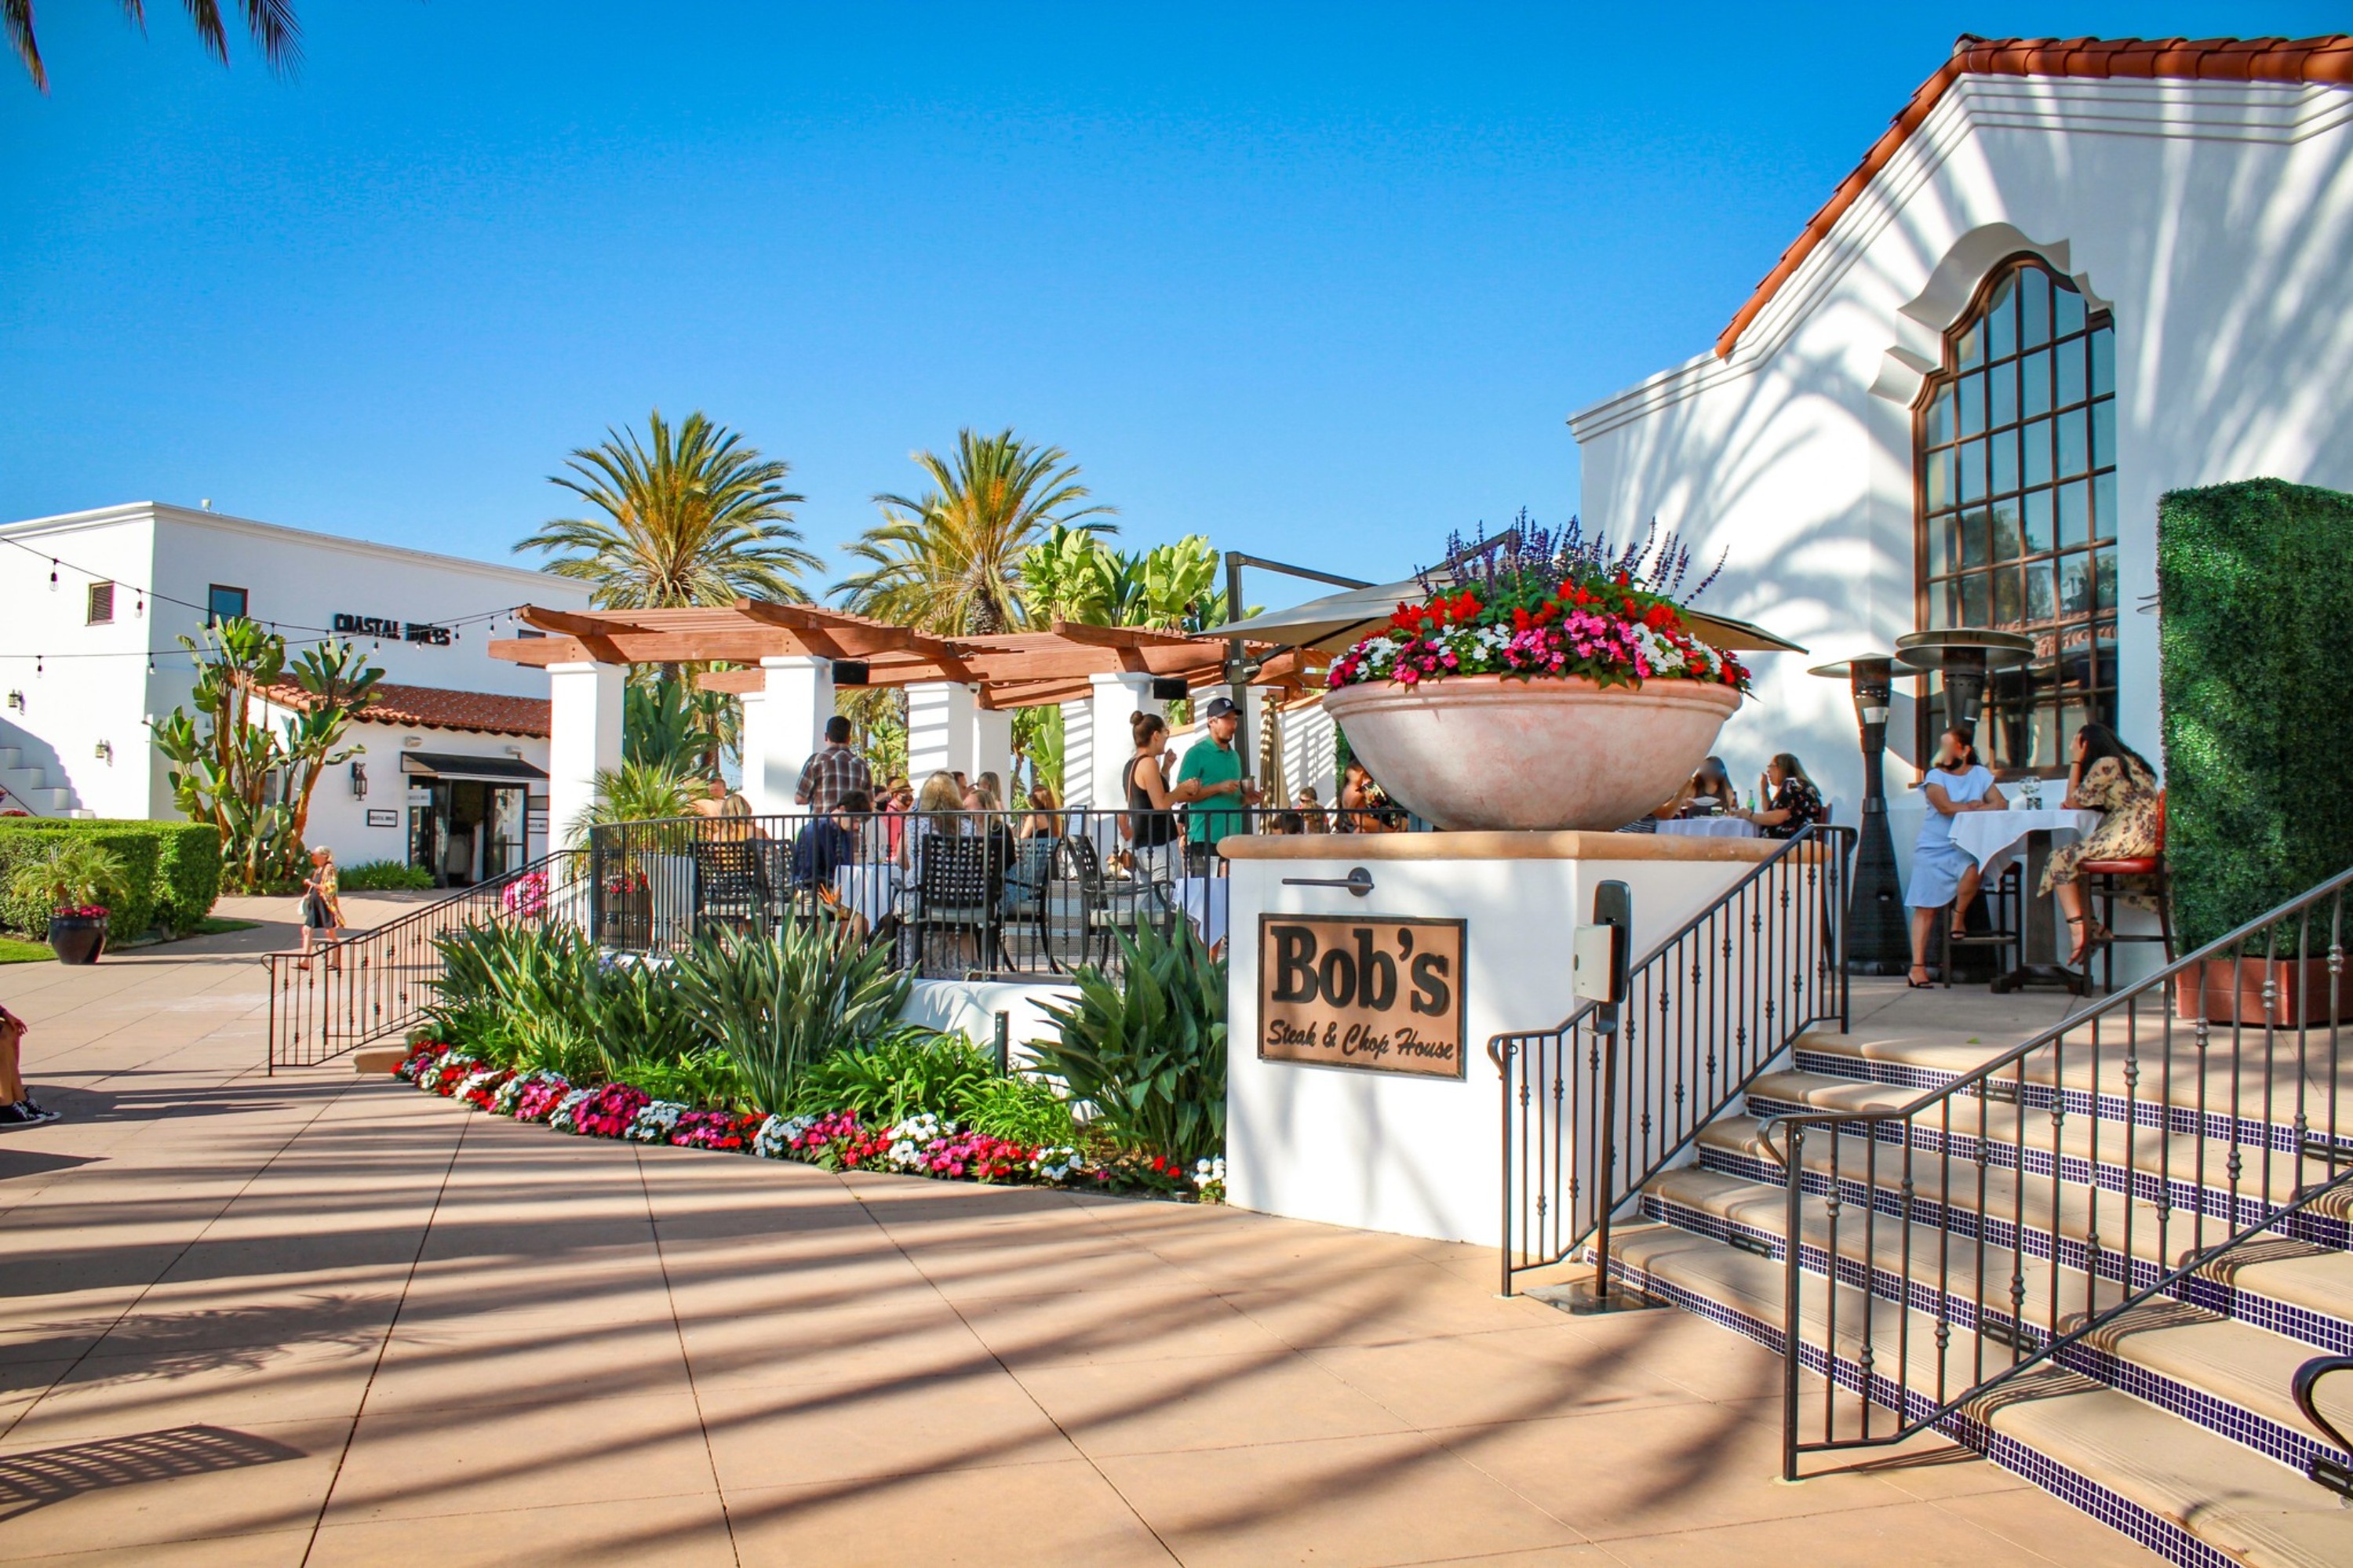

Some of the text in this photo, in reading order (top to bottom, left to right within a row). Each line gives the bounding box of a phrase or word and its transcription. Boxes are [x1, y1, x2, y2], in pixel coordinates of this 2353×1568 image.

[334, 613, 401, 640] COASTAL
[1270, 926, 1451, 1017] Bob's
[1266, 1020, 1454, 1060] Steak & Chop House
